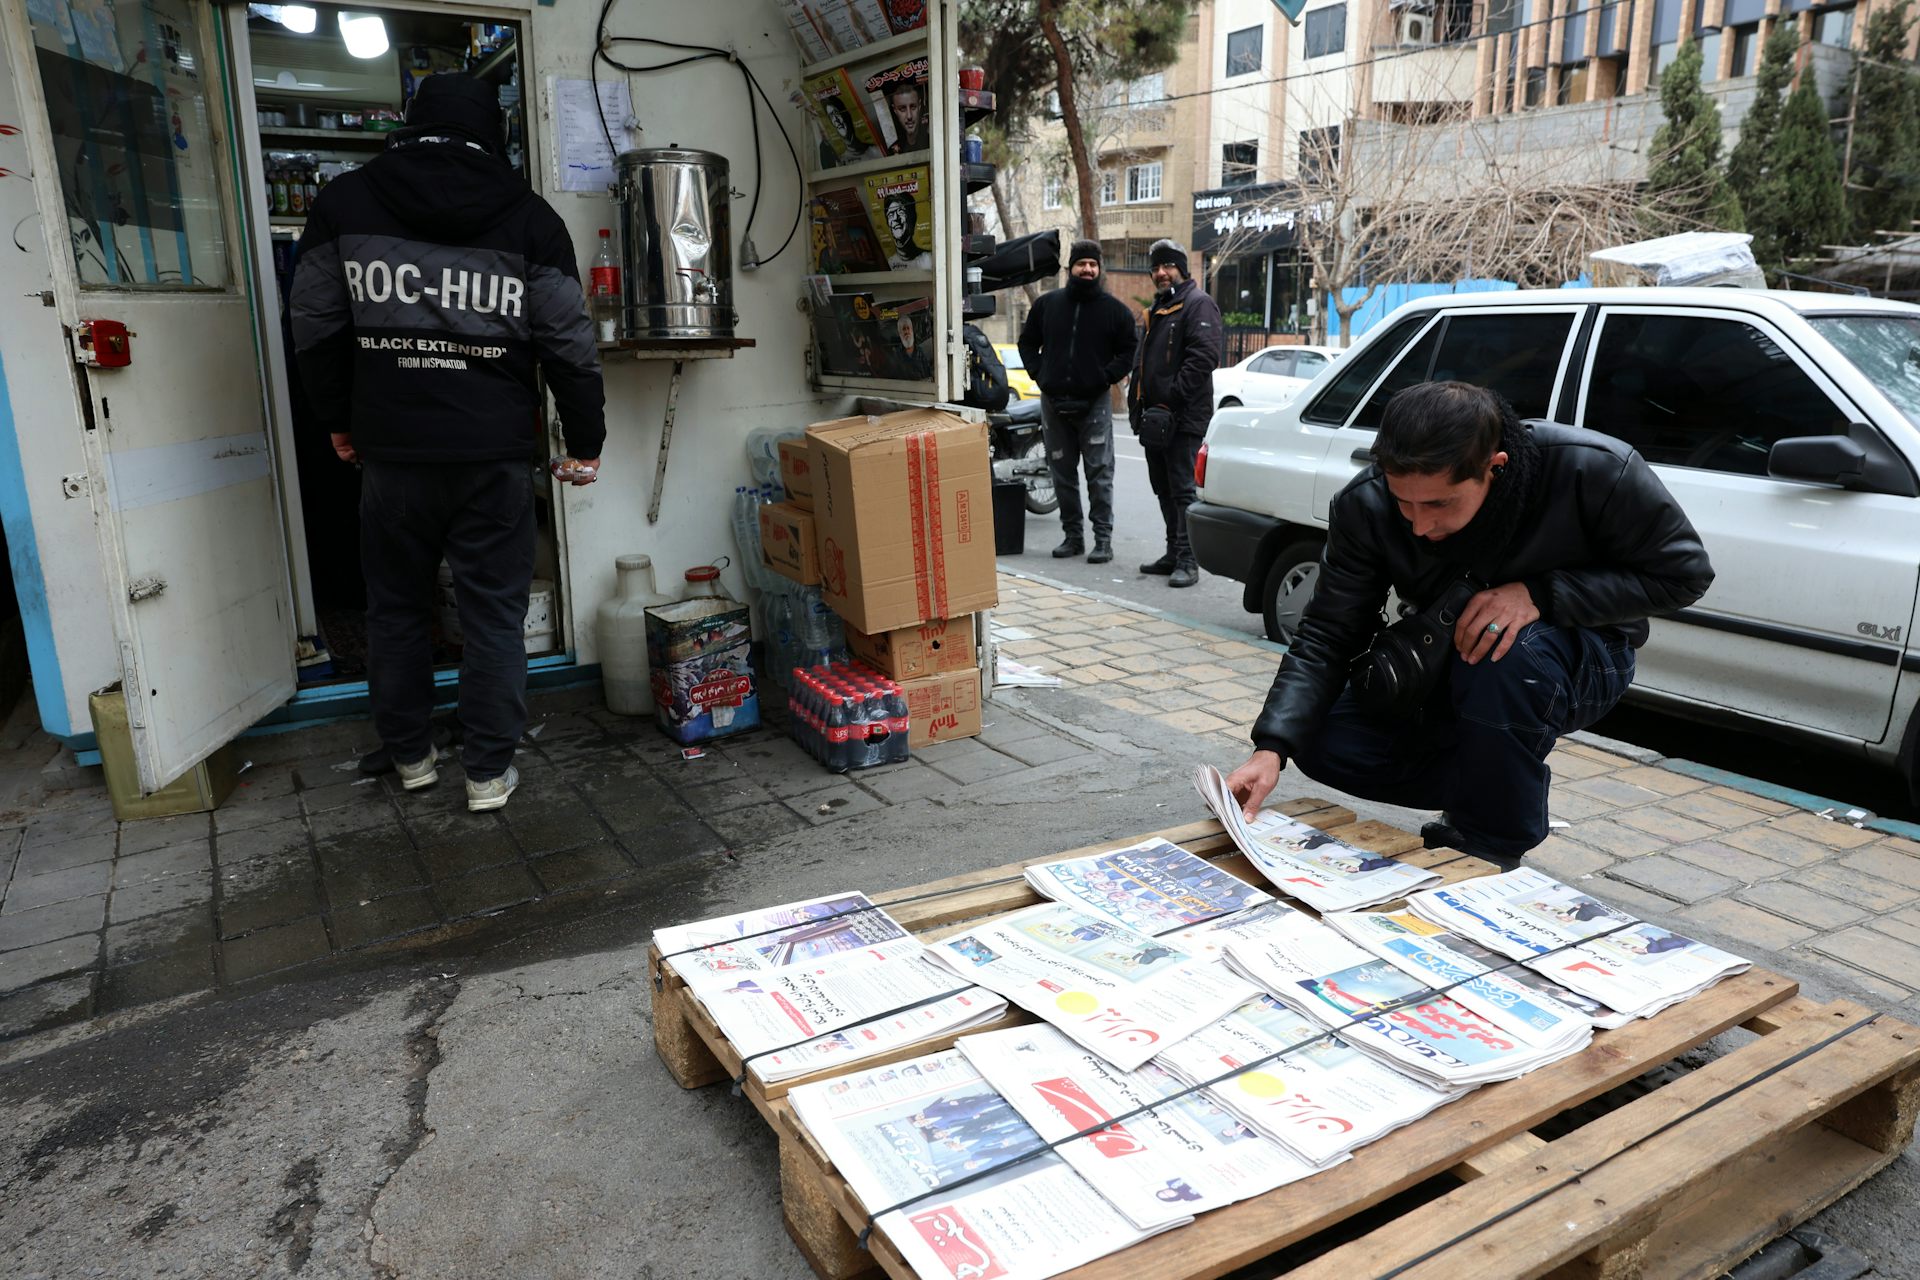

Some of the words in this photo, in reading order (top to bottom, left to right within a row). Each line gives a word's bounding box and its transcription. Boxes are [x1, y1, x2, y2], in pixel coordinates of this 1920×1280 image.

[343, 259, 526, 318] ROC-HUR
[397, 357, 421, 369] FROM
[421, 358, 467, 371] INSPIRATION
[789, 991, 812, 1003] ایران
[799, 973, 816, 984] برای
[1083, 1007, 1160, 1044] ایران
[1391, 1012, 1453, 1038] عصر
[1417, 1000, 1509, 1048] دکترین
[1030, 1083, 1145, 1159] شرق
[1082, 1055, 1127, 1088] دیپلماسی
[1157, 1120, 1203, 1151] خاکستری
[1266, 1093, 1353, 1133] ایران
[873, 1122, 923, 1158] شروع
[903, 1154, 949, 1188] خوب
